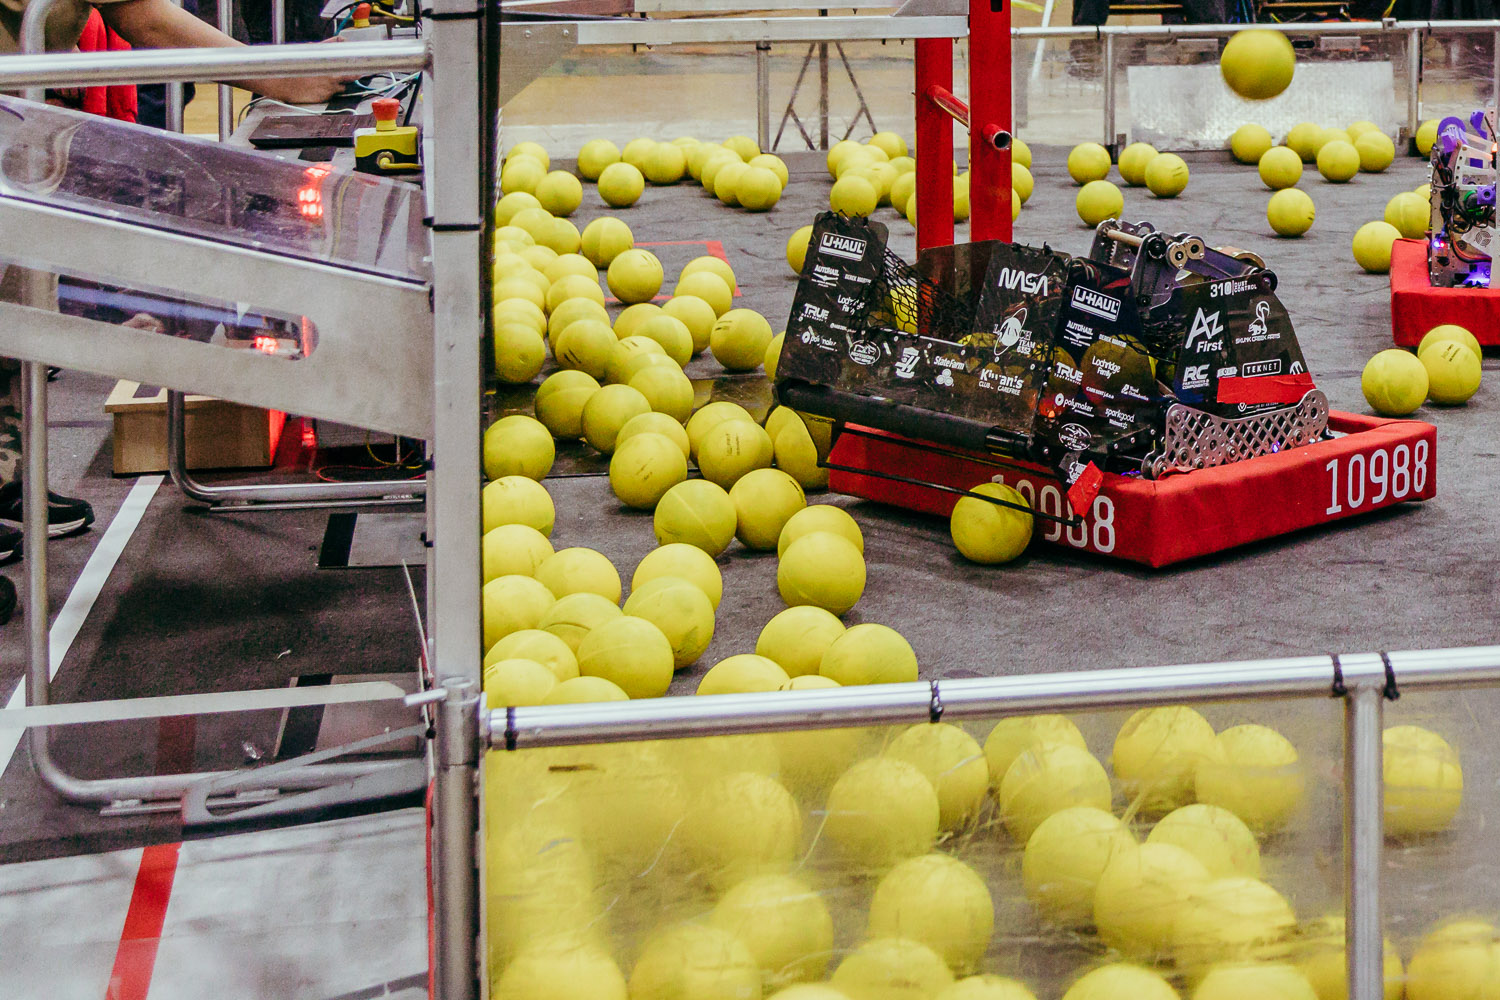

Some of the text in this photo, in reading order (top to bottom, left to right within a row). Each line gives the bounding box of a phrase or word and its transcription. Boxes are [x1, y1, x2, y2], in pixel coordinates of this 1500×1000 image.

[823, 234, 865, 255] U-HAUL
[998, 267, 1048, 297] NASA
[1210, 281, 1232, 298] 310
[1075, 288, 1119, 314] U-HAUL
[804, 302, 830, 320] TRUE
[1018, 340, 1036, 349] TEAM
[1196, 339, 1223, 353] First
[1056, 362, 1084, 382] TRUE
[1183, 364, 1210, 382] RC
[1246, 362, 1277, 374] TEKNET
[1063, 397, 1094, 413] polymaker
[1325, 439, 1429, 515] 10988
